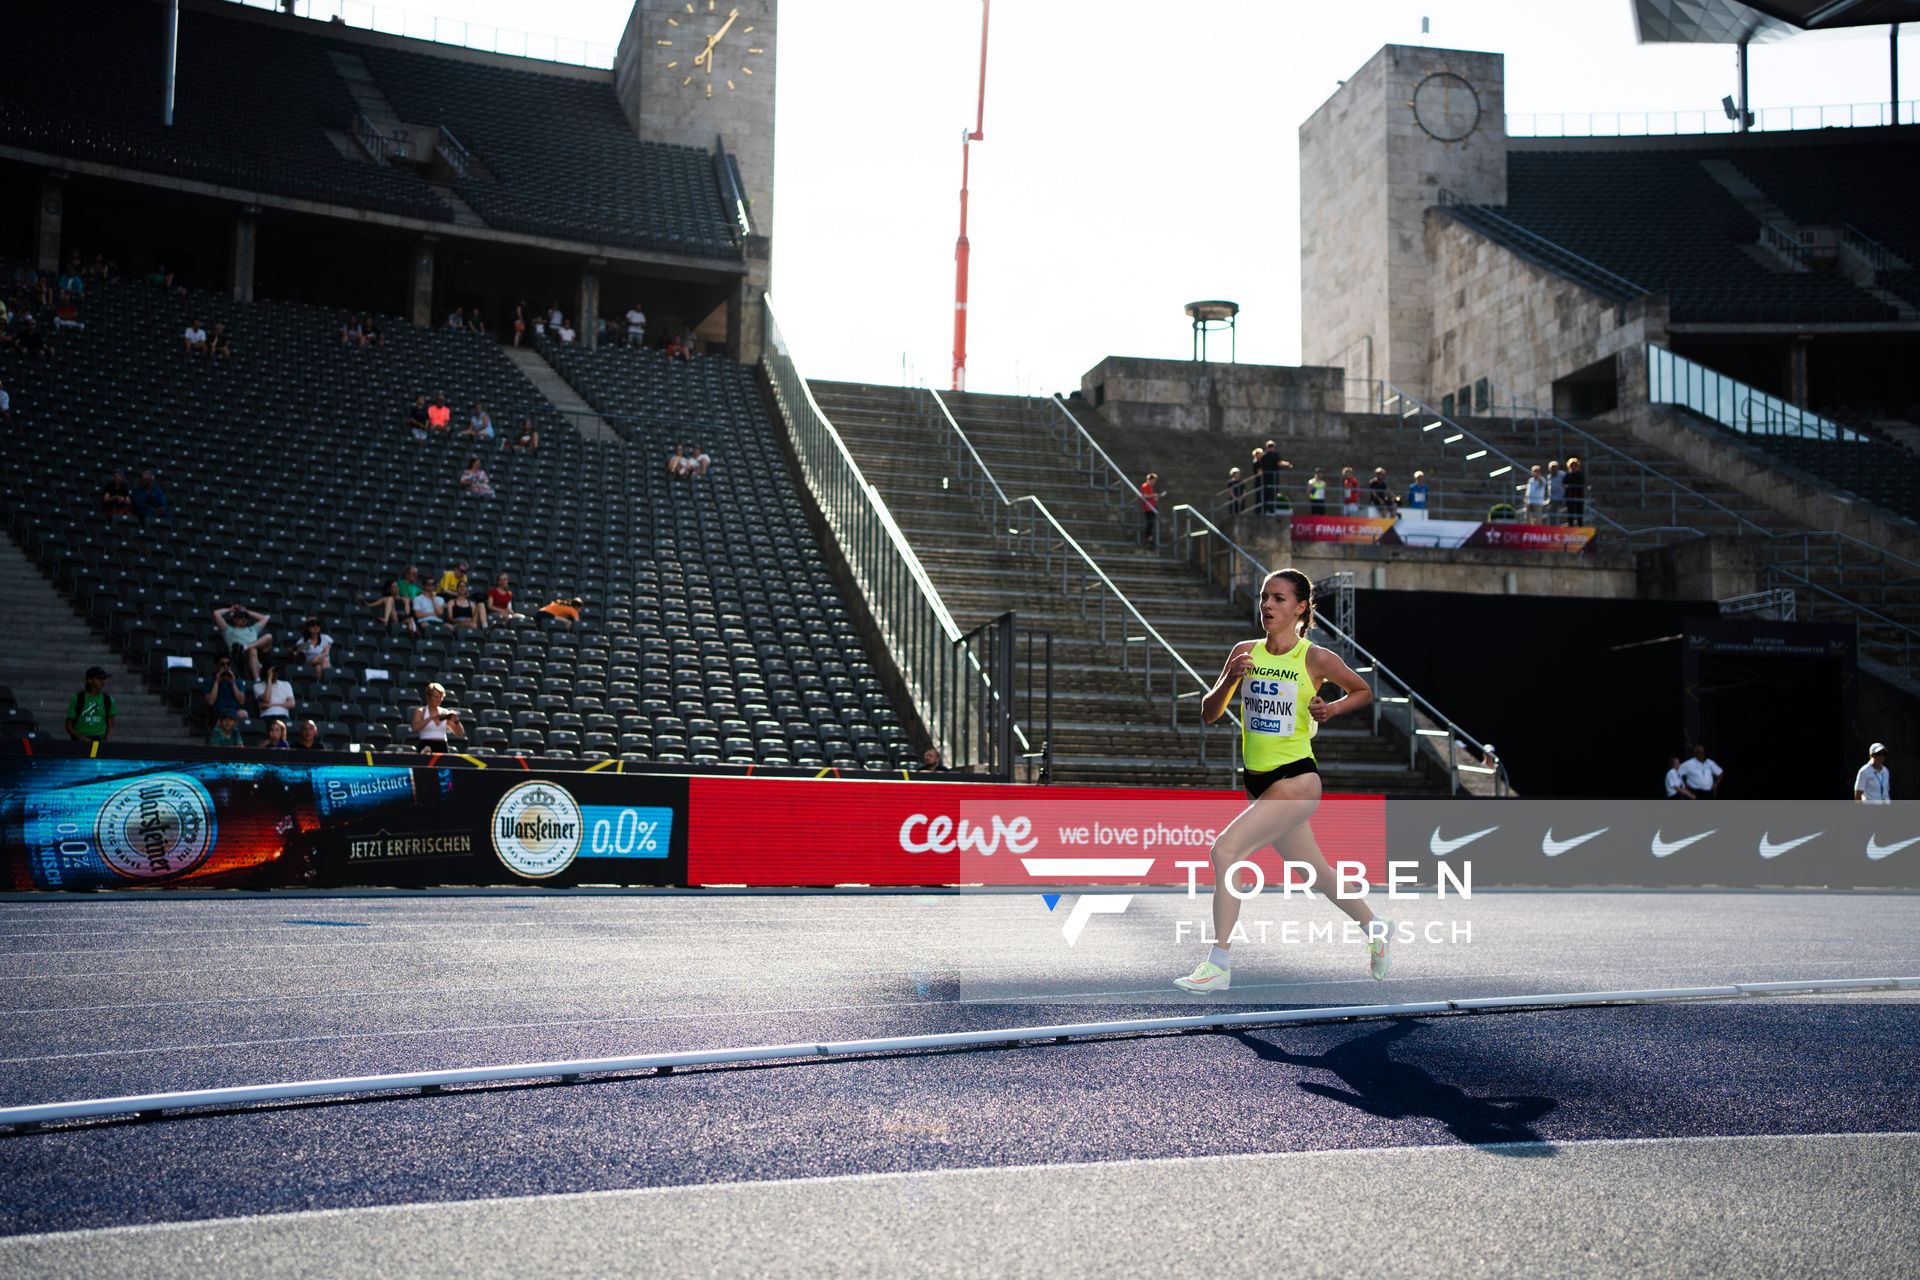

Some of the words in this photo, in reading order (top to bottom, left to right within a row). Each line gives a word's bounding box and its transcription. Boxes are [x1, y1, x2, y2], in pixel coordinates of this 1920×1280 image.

[1296, 523, 1312, 536] DIE
[1315, 524, 1355, 537] FINALS
[1504, 531, 1521, 544] DIE
[1522, 532, 1560, 545] FINALS
[1244, 697, 1293, 716] PINGPANK
[1260, 721, 1279, 729] PLAN
[350, 776, 408, 797] Warsteiner
[139, 783, 171, 872] Warsteiner
[501, 814, 576, 842] Warsteiner
[591, 808, 659, 855] 0,0%
[899, 813, 1039, 856] cewe
[1058, 826, 1090, 845] we
[1094, 821, 1139, 845] love
[1143, 822, 1217, 850] photos
[350, 840, 383, 859] JETZT
[387, 836, 471, 856] ERFRISCHEN
